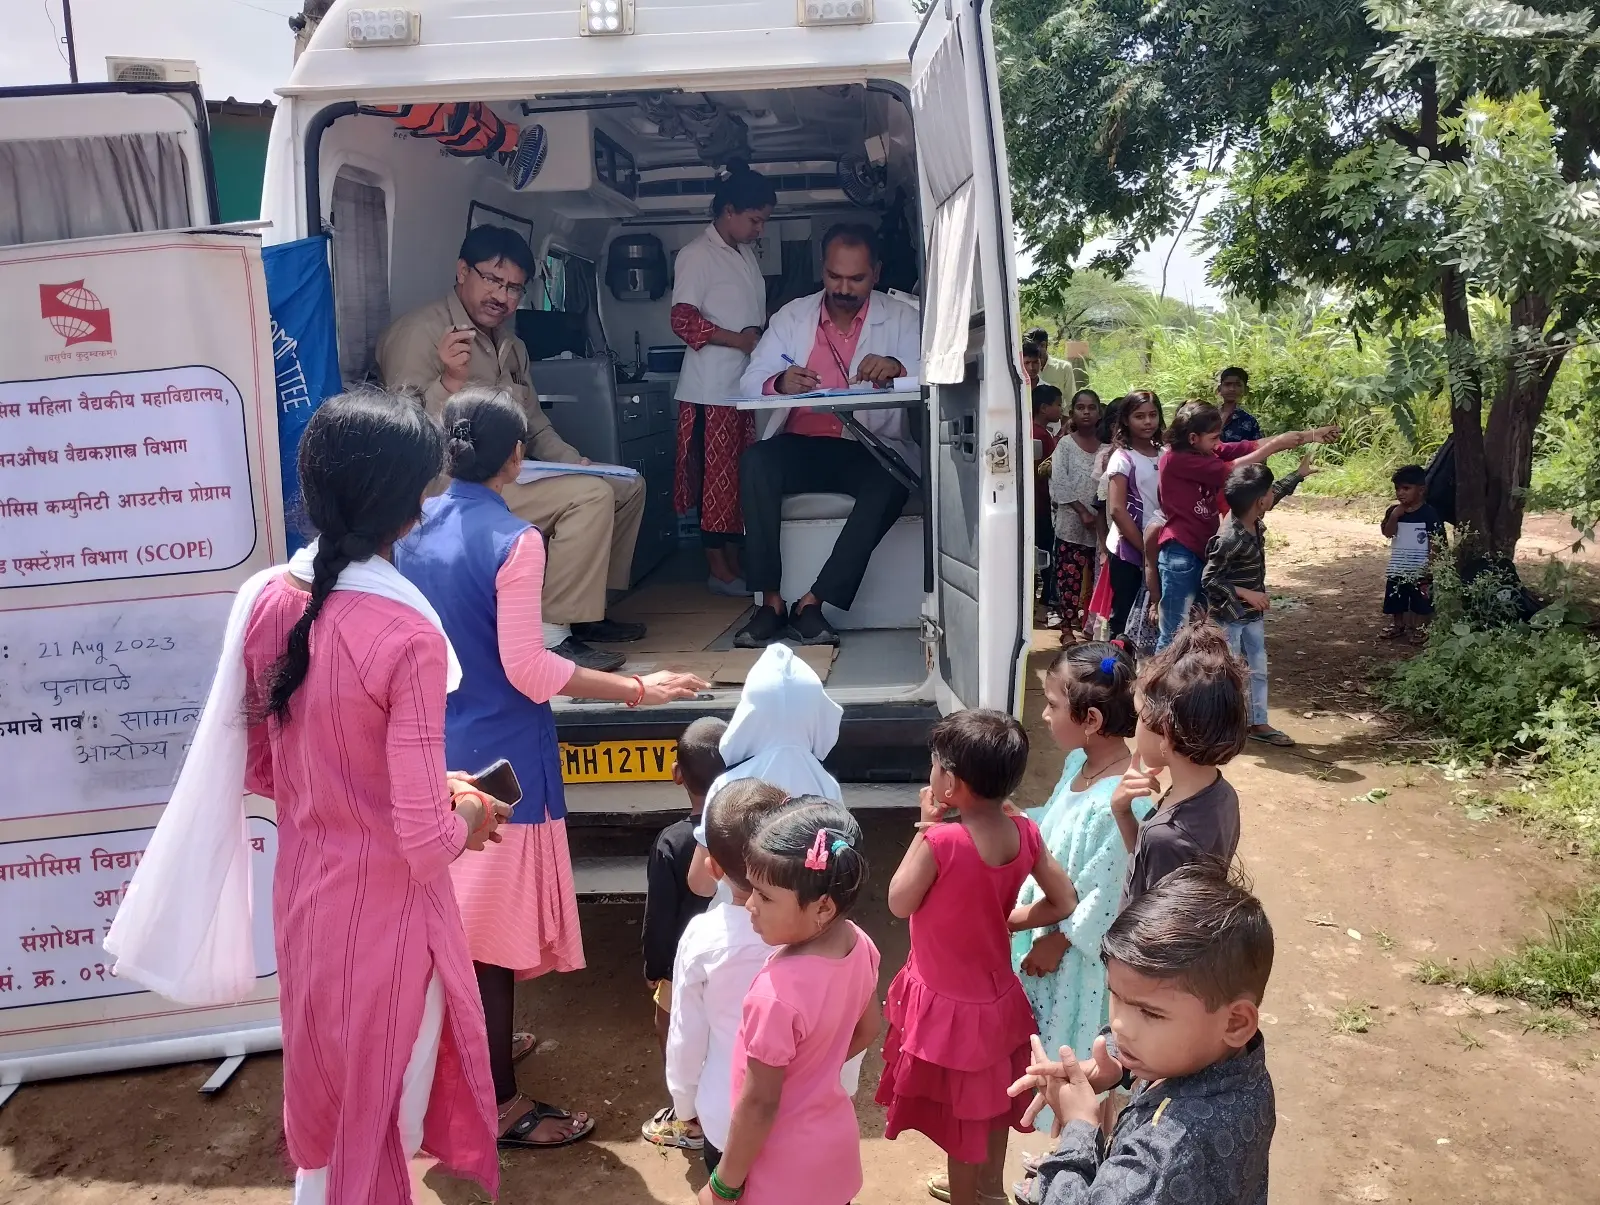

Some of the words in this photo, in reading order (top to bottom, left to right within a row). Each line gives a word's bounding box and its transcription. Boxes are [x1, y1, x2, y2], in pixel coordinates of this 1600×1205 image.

[27, 396, 72, 417] महिला
[78, 390, 135, 411] वैद्यकीय
[140, 384, 230, 407] महाविद्यालय,
[143, 436, 188, 456] विभाग
[44, 490, 110, 519] कम्युनिटी
[117, 486, 183, 508] आउटरीच
[188, 481, 231, 502] प्रोग्राम
[12, 549, 75, 577] एक्स्टेंशन
[80, 546, 128, 567] विभाग
[136, 537, 213, 566] (SCOPE)
[38, 641, 63, 659] 21
[72, 640, 108, 664] Aug
[114, 637, 175, 653] 2023
[40, 663, 132, 707] पुनावळे
[50, 714, 83, 732] नाव
[75, 733, 168, 764] आरोग्य
[19, 924, 95, 953] संशोधन
